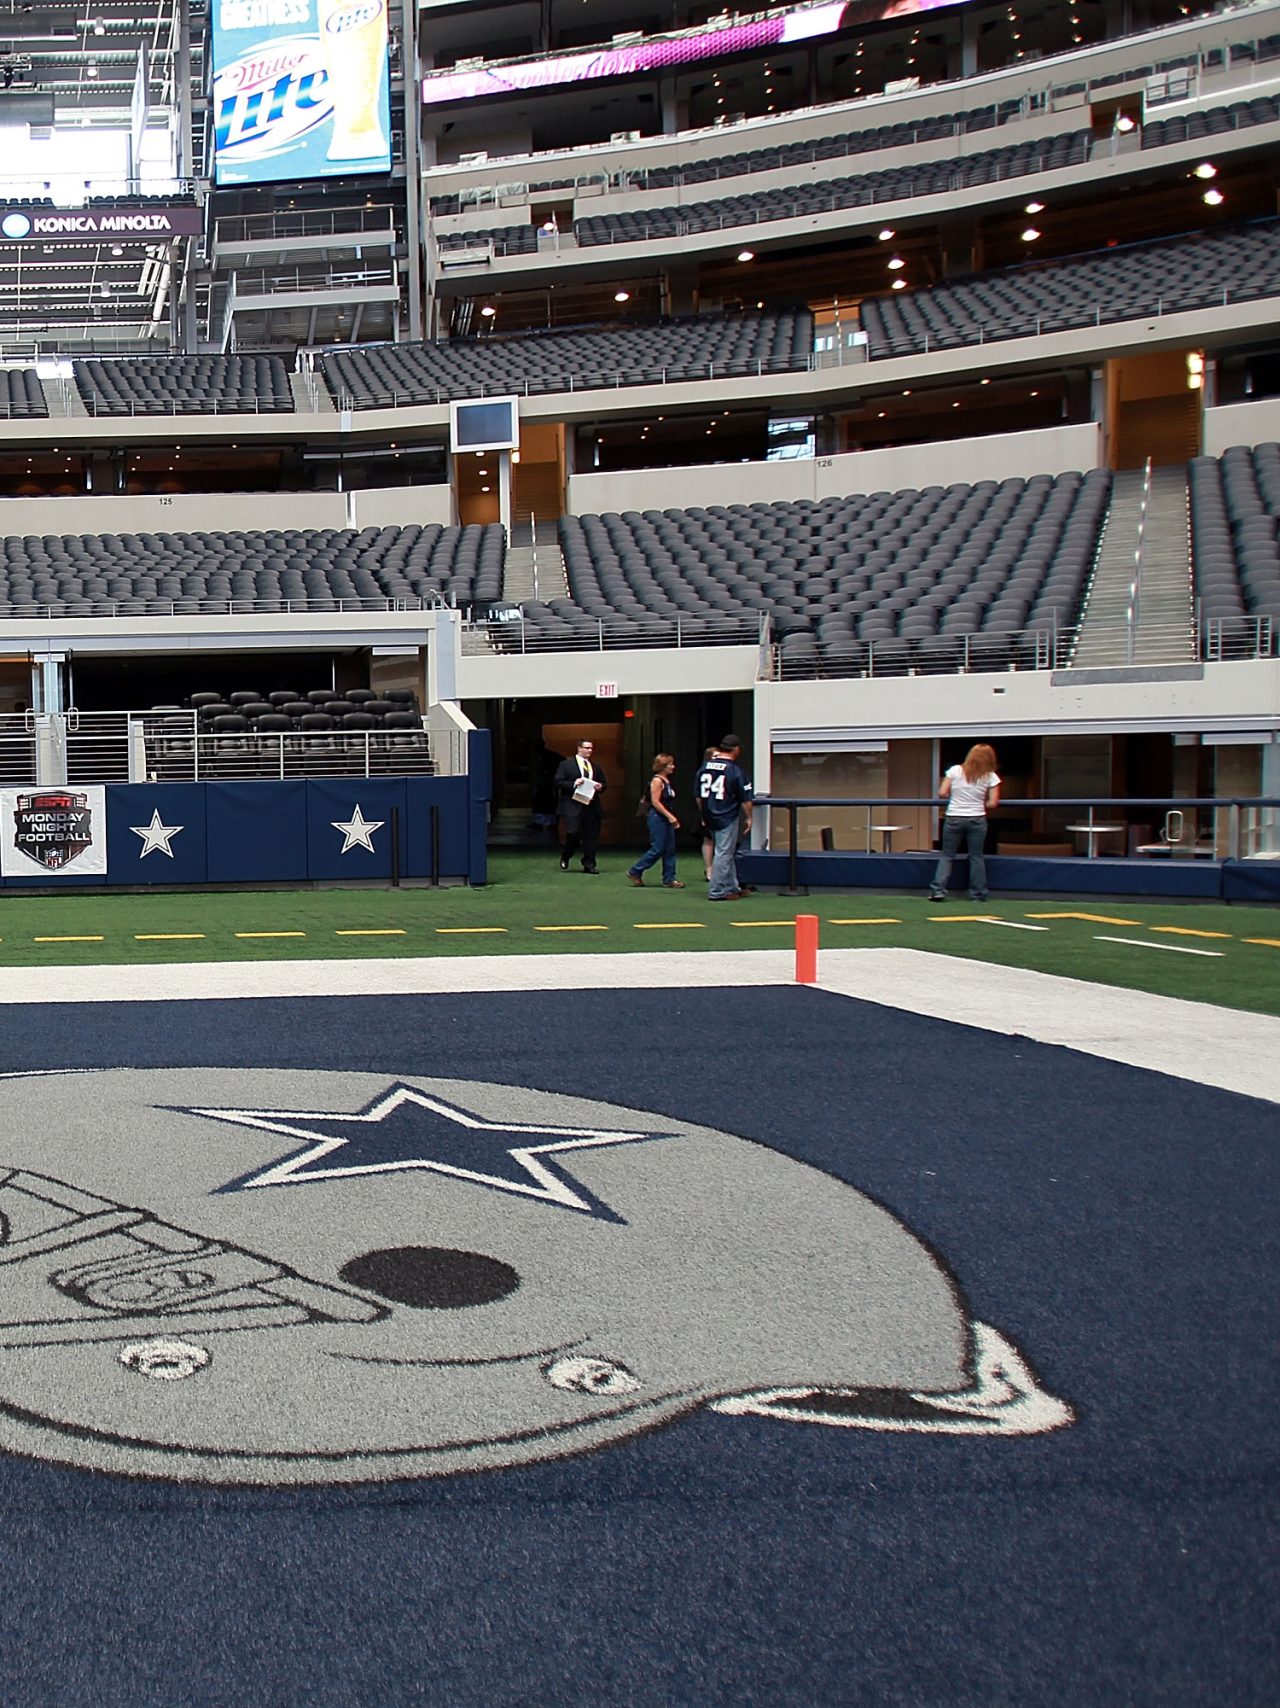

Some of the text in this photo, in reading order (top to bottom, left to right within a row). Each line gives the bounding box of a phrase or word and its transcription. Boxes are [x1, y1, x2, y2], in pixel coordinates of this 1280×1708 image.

[216, 69, 329, 150] Lite
[33, 215, 171, 233] KONICA MINOLTA
[817, 460, 833, 468] 126
[600, 684, 615, 696] EXIT
[700, 773, 725, 800] 24
[35, 797, 72, 807] ESPN
[22, 813, 84, 823] MONDAY
[31, 823, 76, 832] NIGHT
[18, 832, 90, 842] FOOTBALL
